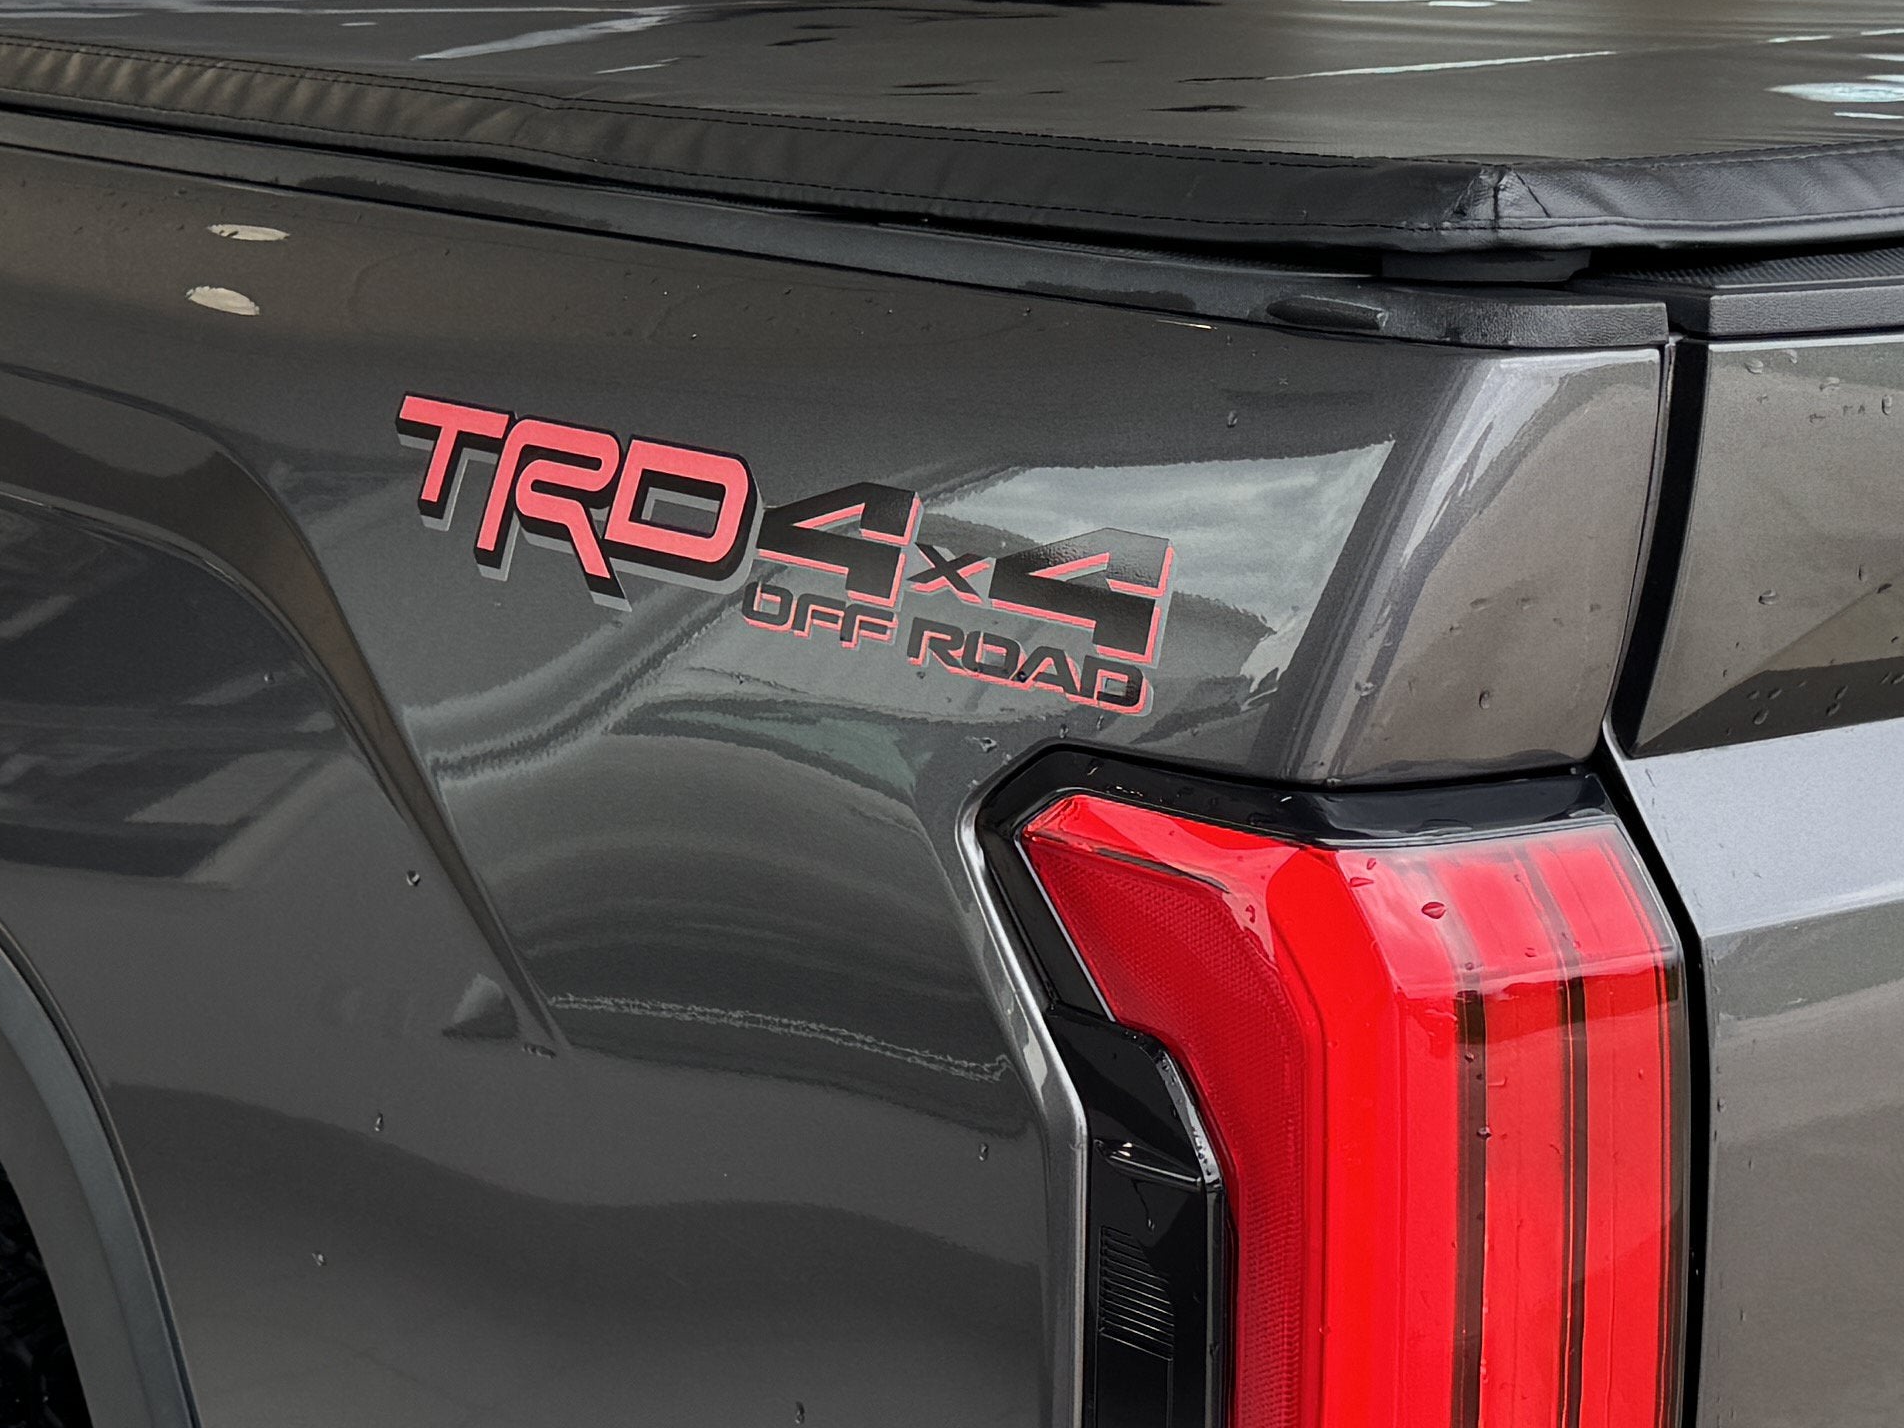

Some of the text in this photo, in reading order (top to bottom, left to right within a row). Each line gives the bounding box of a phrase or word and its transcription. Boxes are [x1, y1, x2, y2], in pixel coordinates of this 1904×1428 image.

[395, 392, 761, 612] TRD
[741, 580, 1154, 716] OFF ROAD
